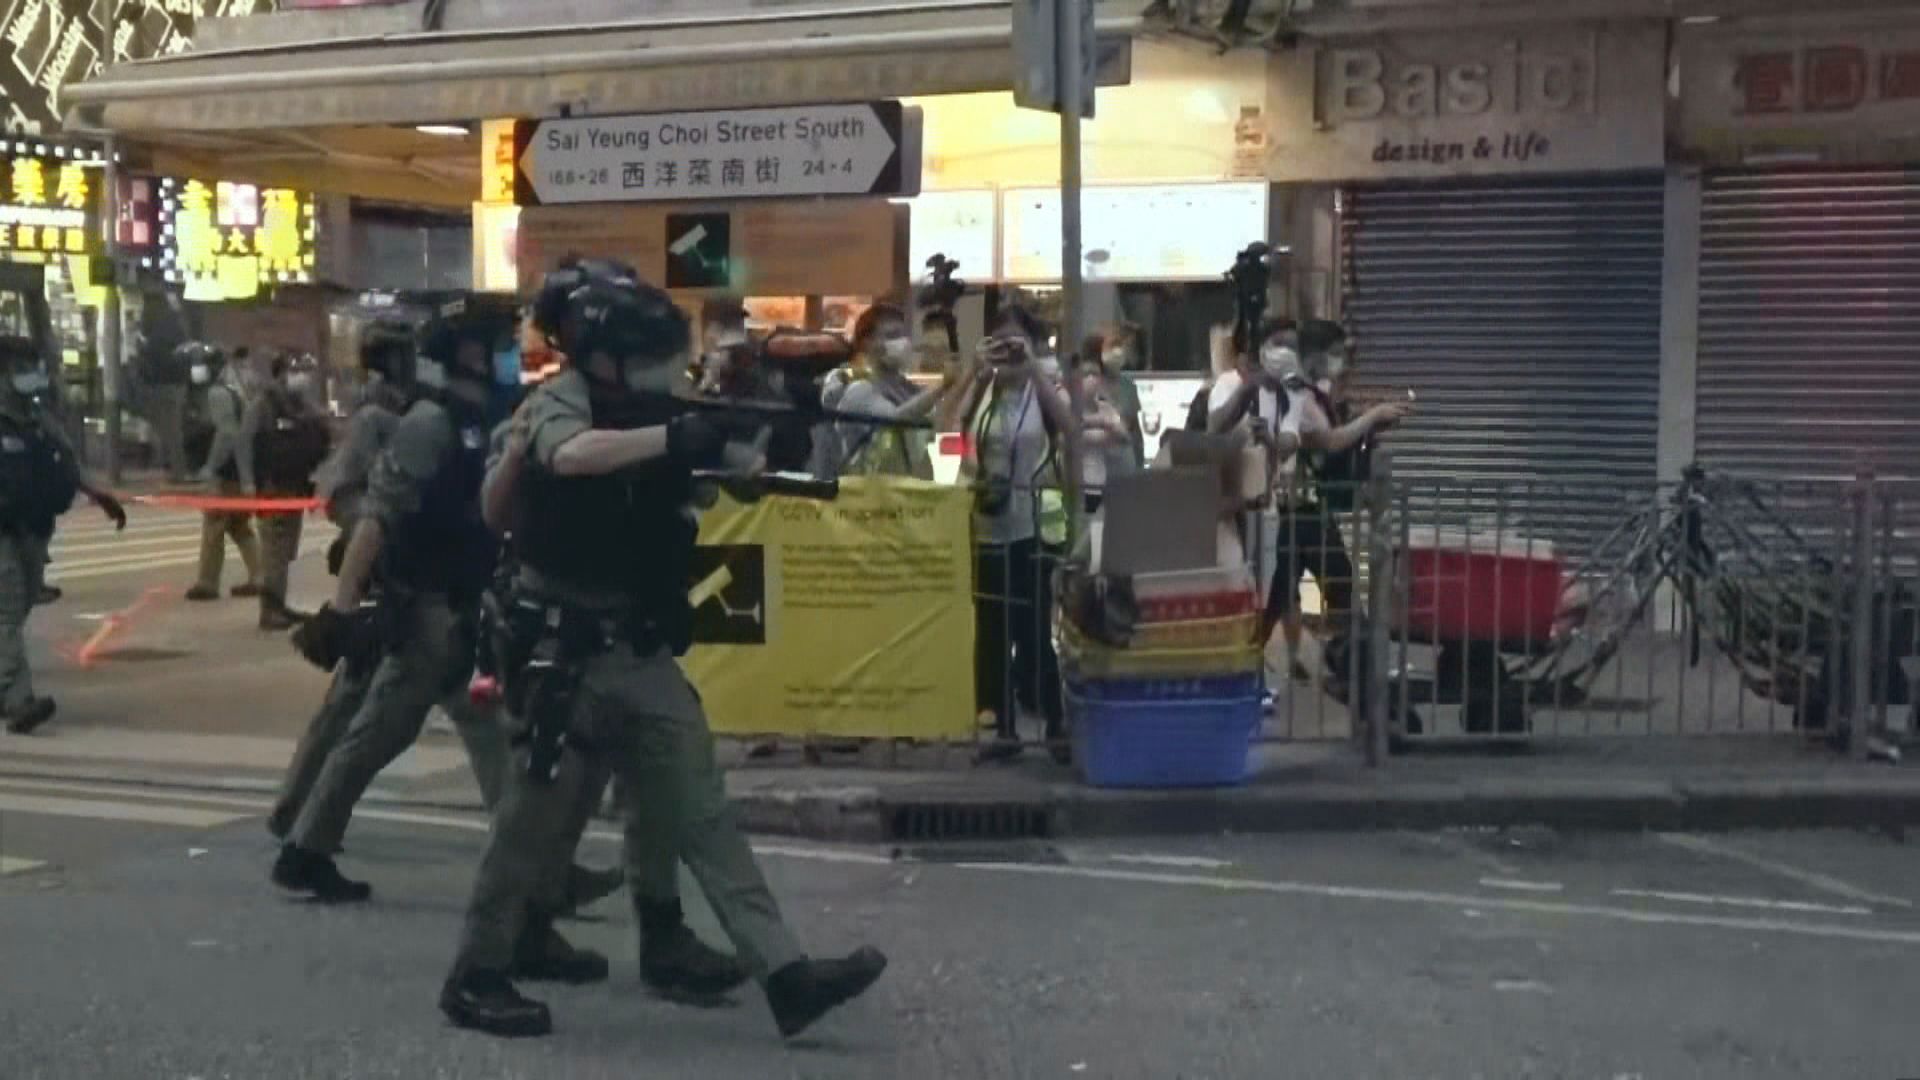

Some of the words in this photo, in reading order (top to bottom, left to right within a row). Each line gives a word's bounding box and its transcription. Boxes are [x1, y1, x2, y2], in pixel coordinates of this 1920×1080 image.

[547, 129, 579, 151] Sai
[587, 127, 649, 150] Yeung
[658, 123, 708, 146] Choi
[717, 119, 786, 143] Street
[795, 116, 864, 140] South
[1373, 137, 1464, 163] design
[1473, 136, 1493, 159] &
[1502, 130, 1550, 160] life
[621, 156, 780, 188] 西洋菜南街
